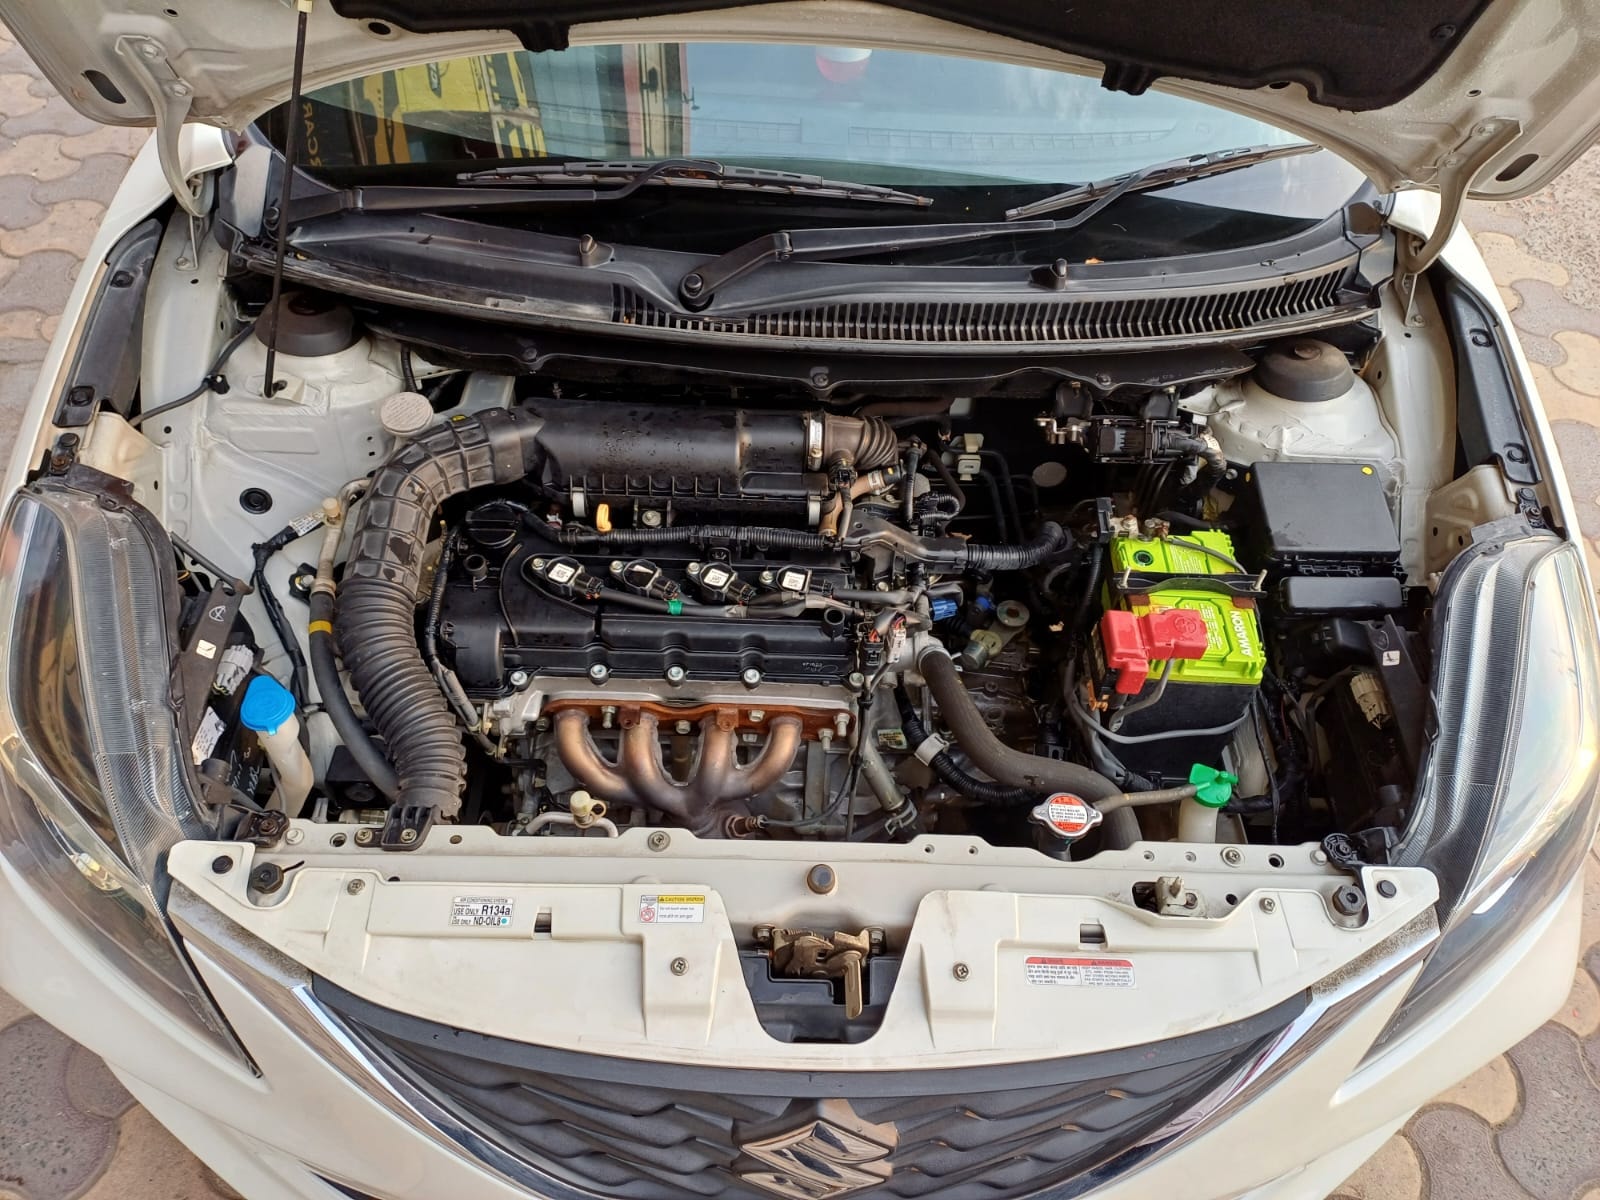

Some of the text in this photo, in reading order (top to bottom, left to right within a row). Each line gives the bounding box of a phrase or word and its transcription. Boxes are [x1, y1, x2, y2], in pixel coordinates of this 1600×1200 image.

[1229, 610, 1253, 657] AMARON
[453, 907, 464, 915] USE
[481, 904, 511, 916] R134a
